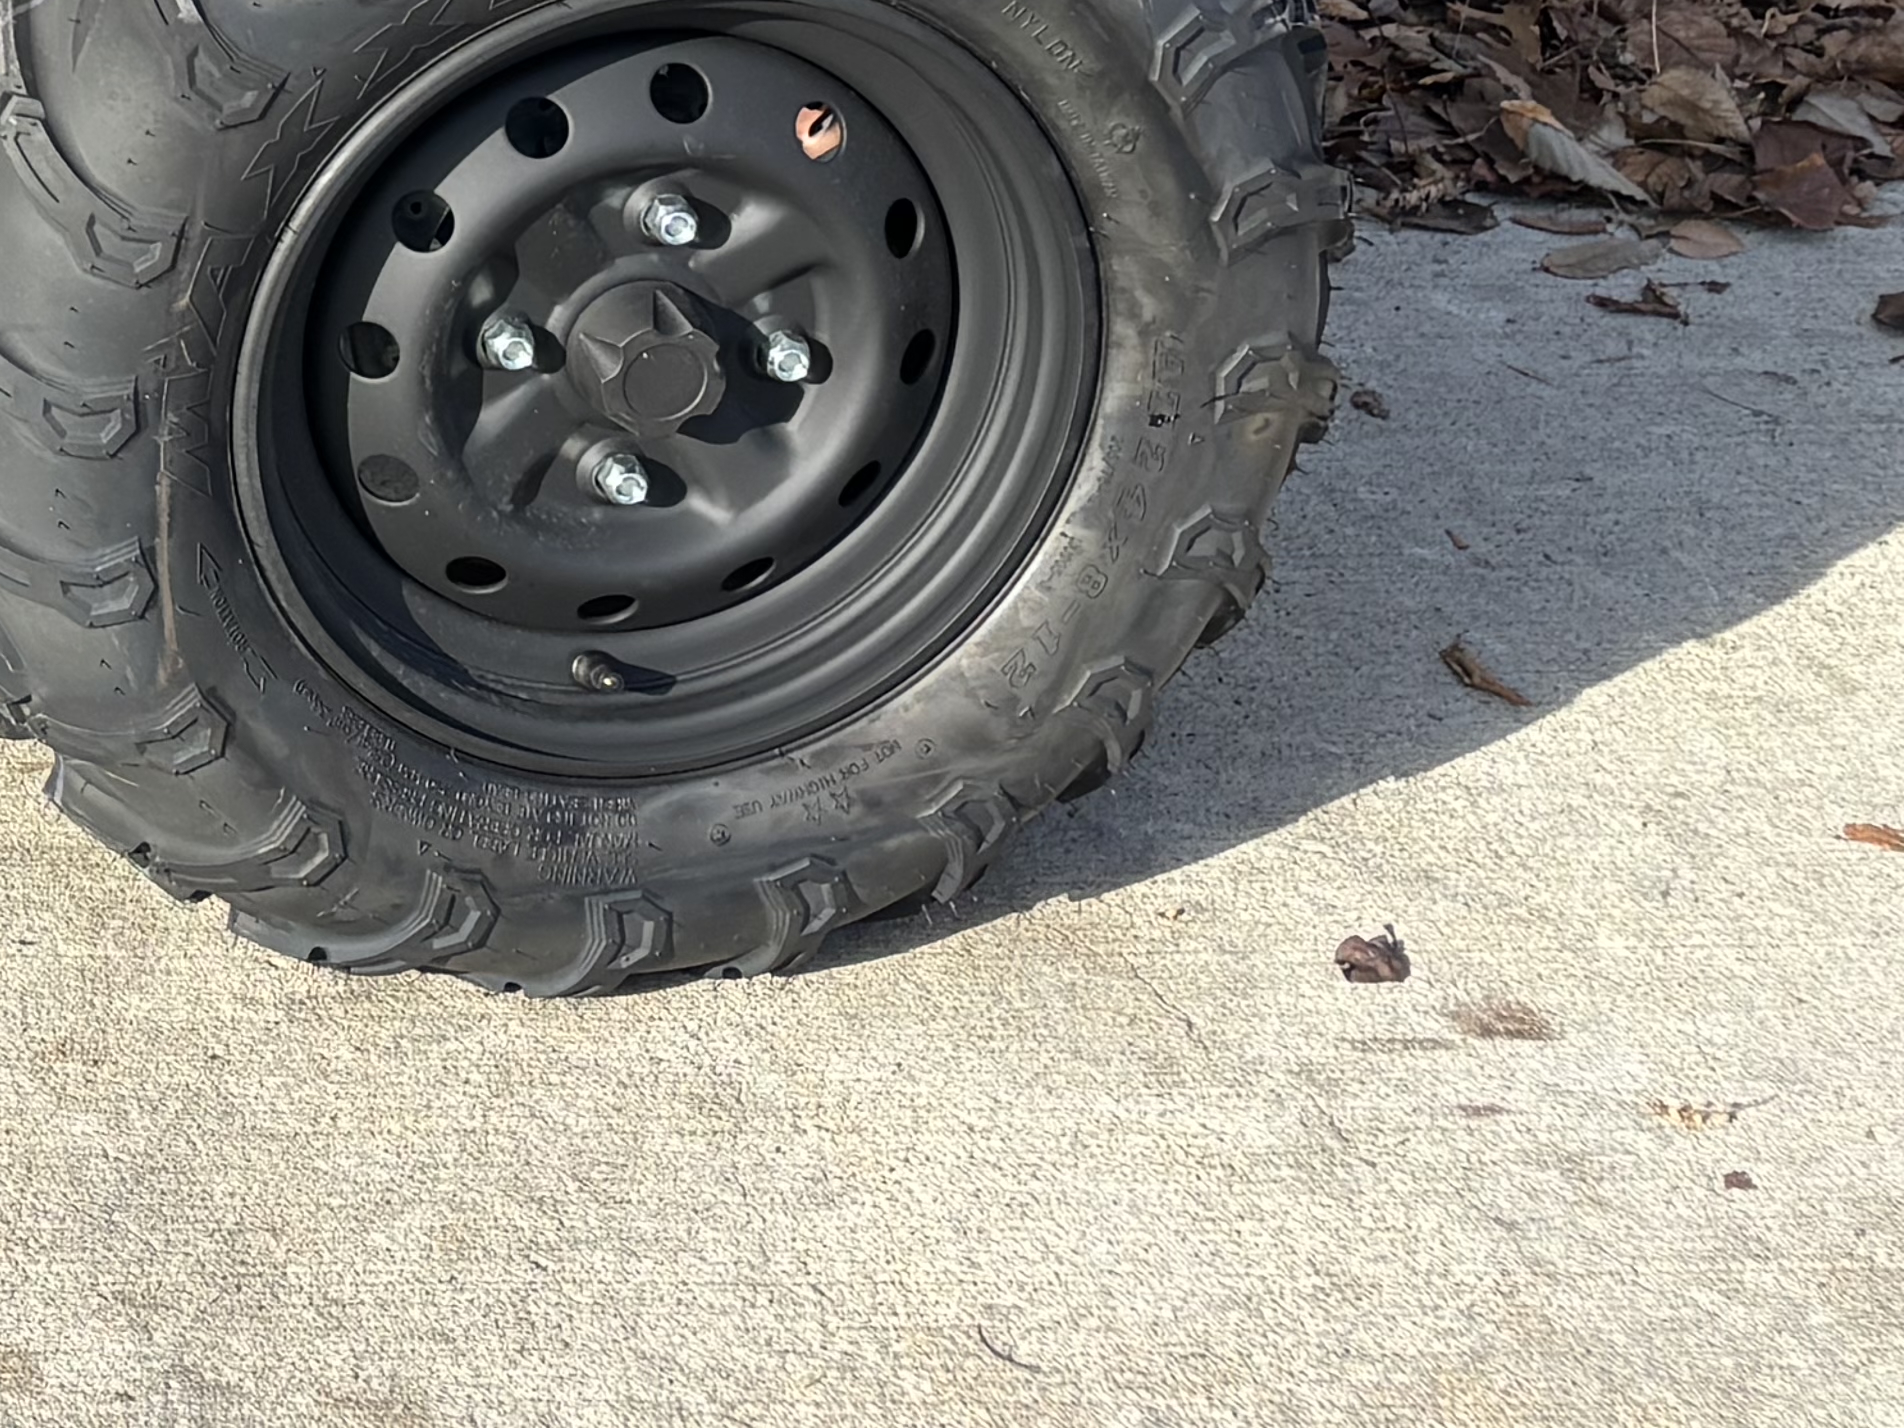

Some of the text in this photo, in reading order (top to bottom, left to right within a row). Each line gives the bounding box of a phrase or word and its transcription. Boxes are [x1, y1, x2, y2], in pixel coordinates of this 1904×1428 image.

[204, 584, 254, 657] ROTATION
[836, 756, 870, 781] FOR
[536, 864, 636, 886] WARNING
